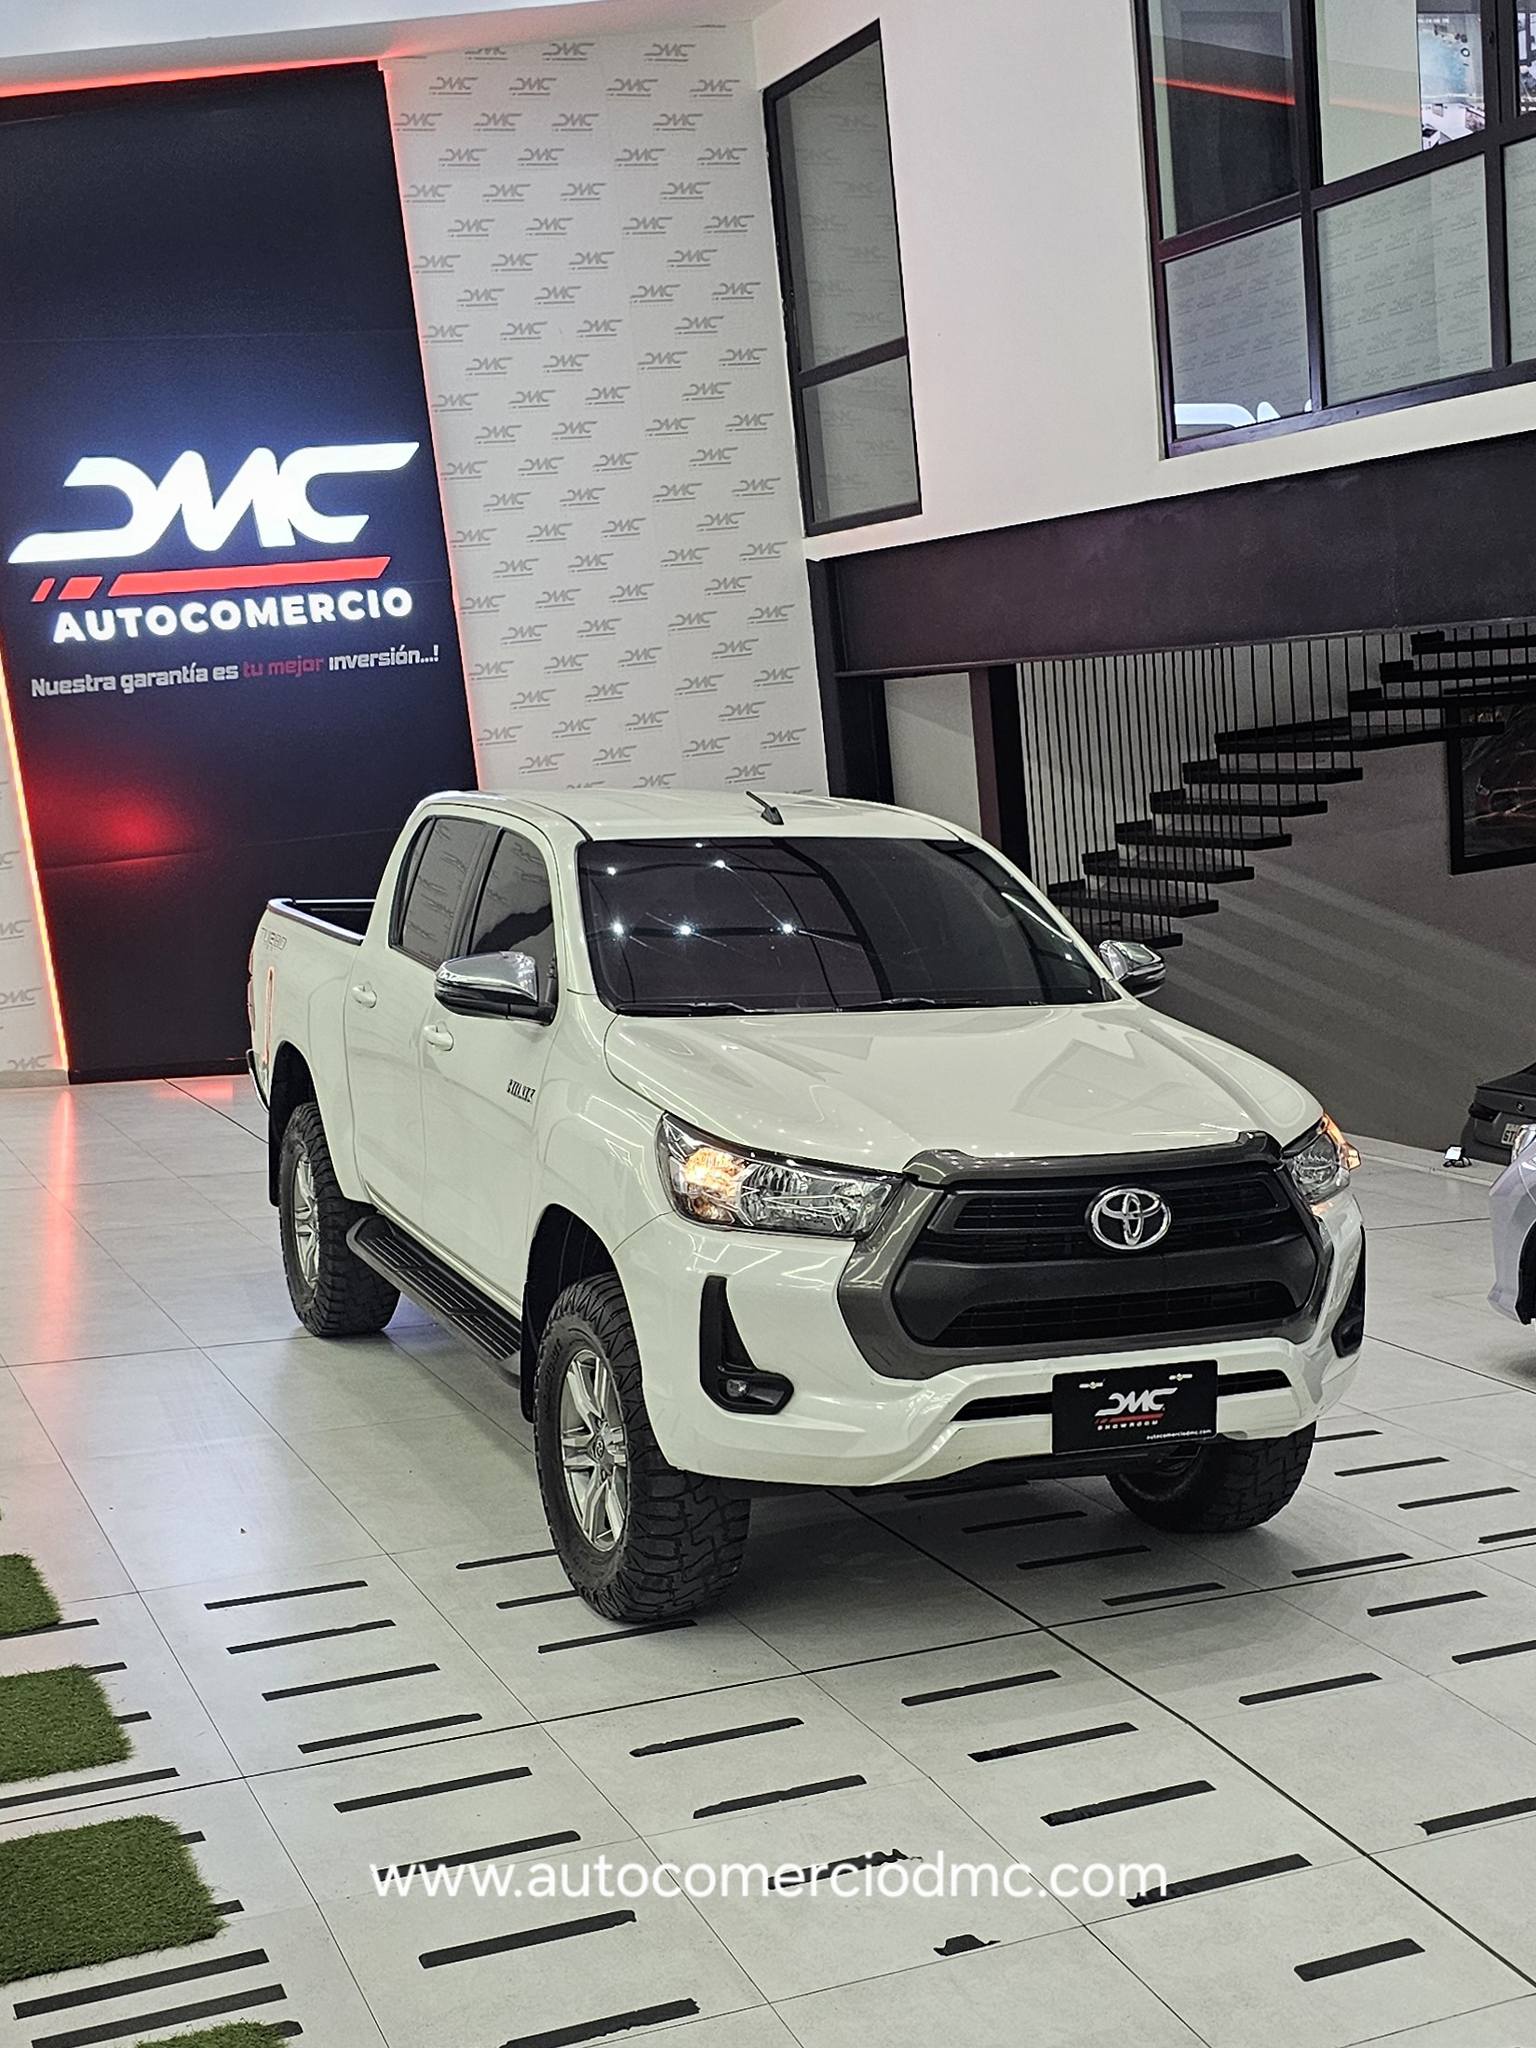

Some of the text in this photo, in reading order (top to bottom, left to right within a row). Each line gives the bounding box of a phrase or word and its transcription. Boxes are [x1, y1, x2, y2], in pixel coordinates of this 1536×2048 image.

[7, 442, 419, 563] DMC
[52, 586, 413, 644] AUTOCOMERCIO
[31, 674, 116, 697] Nuestra
[120, 662, 208, 694] garantía
[212, 665, 239, 681] es
[243, 661, 263, 677] tu
[268, 655, 325, 677] mejor
[1094, 1387, 1178, 1417] DMC
